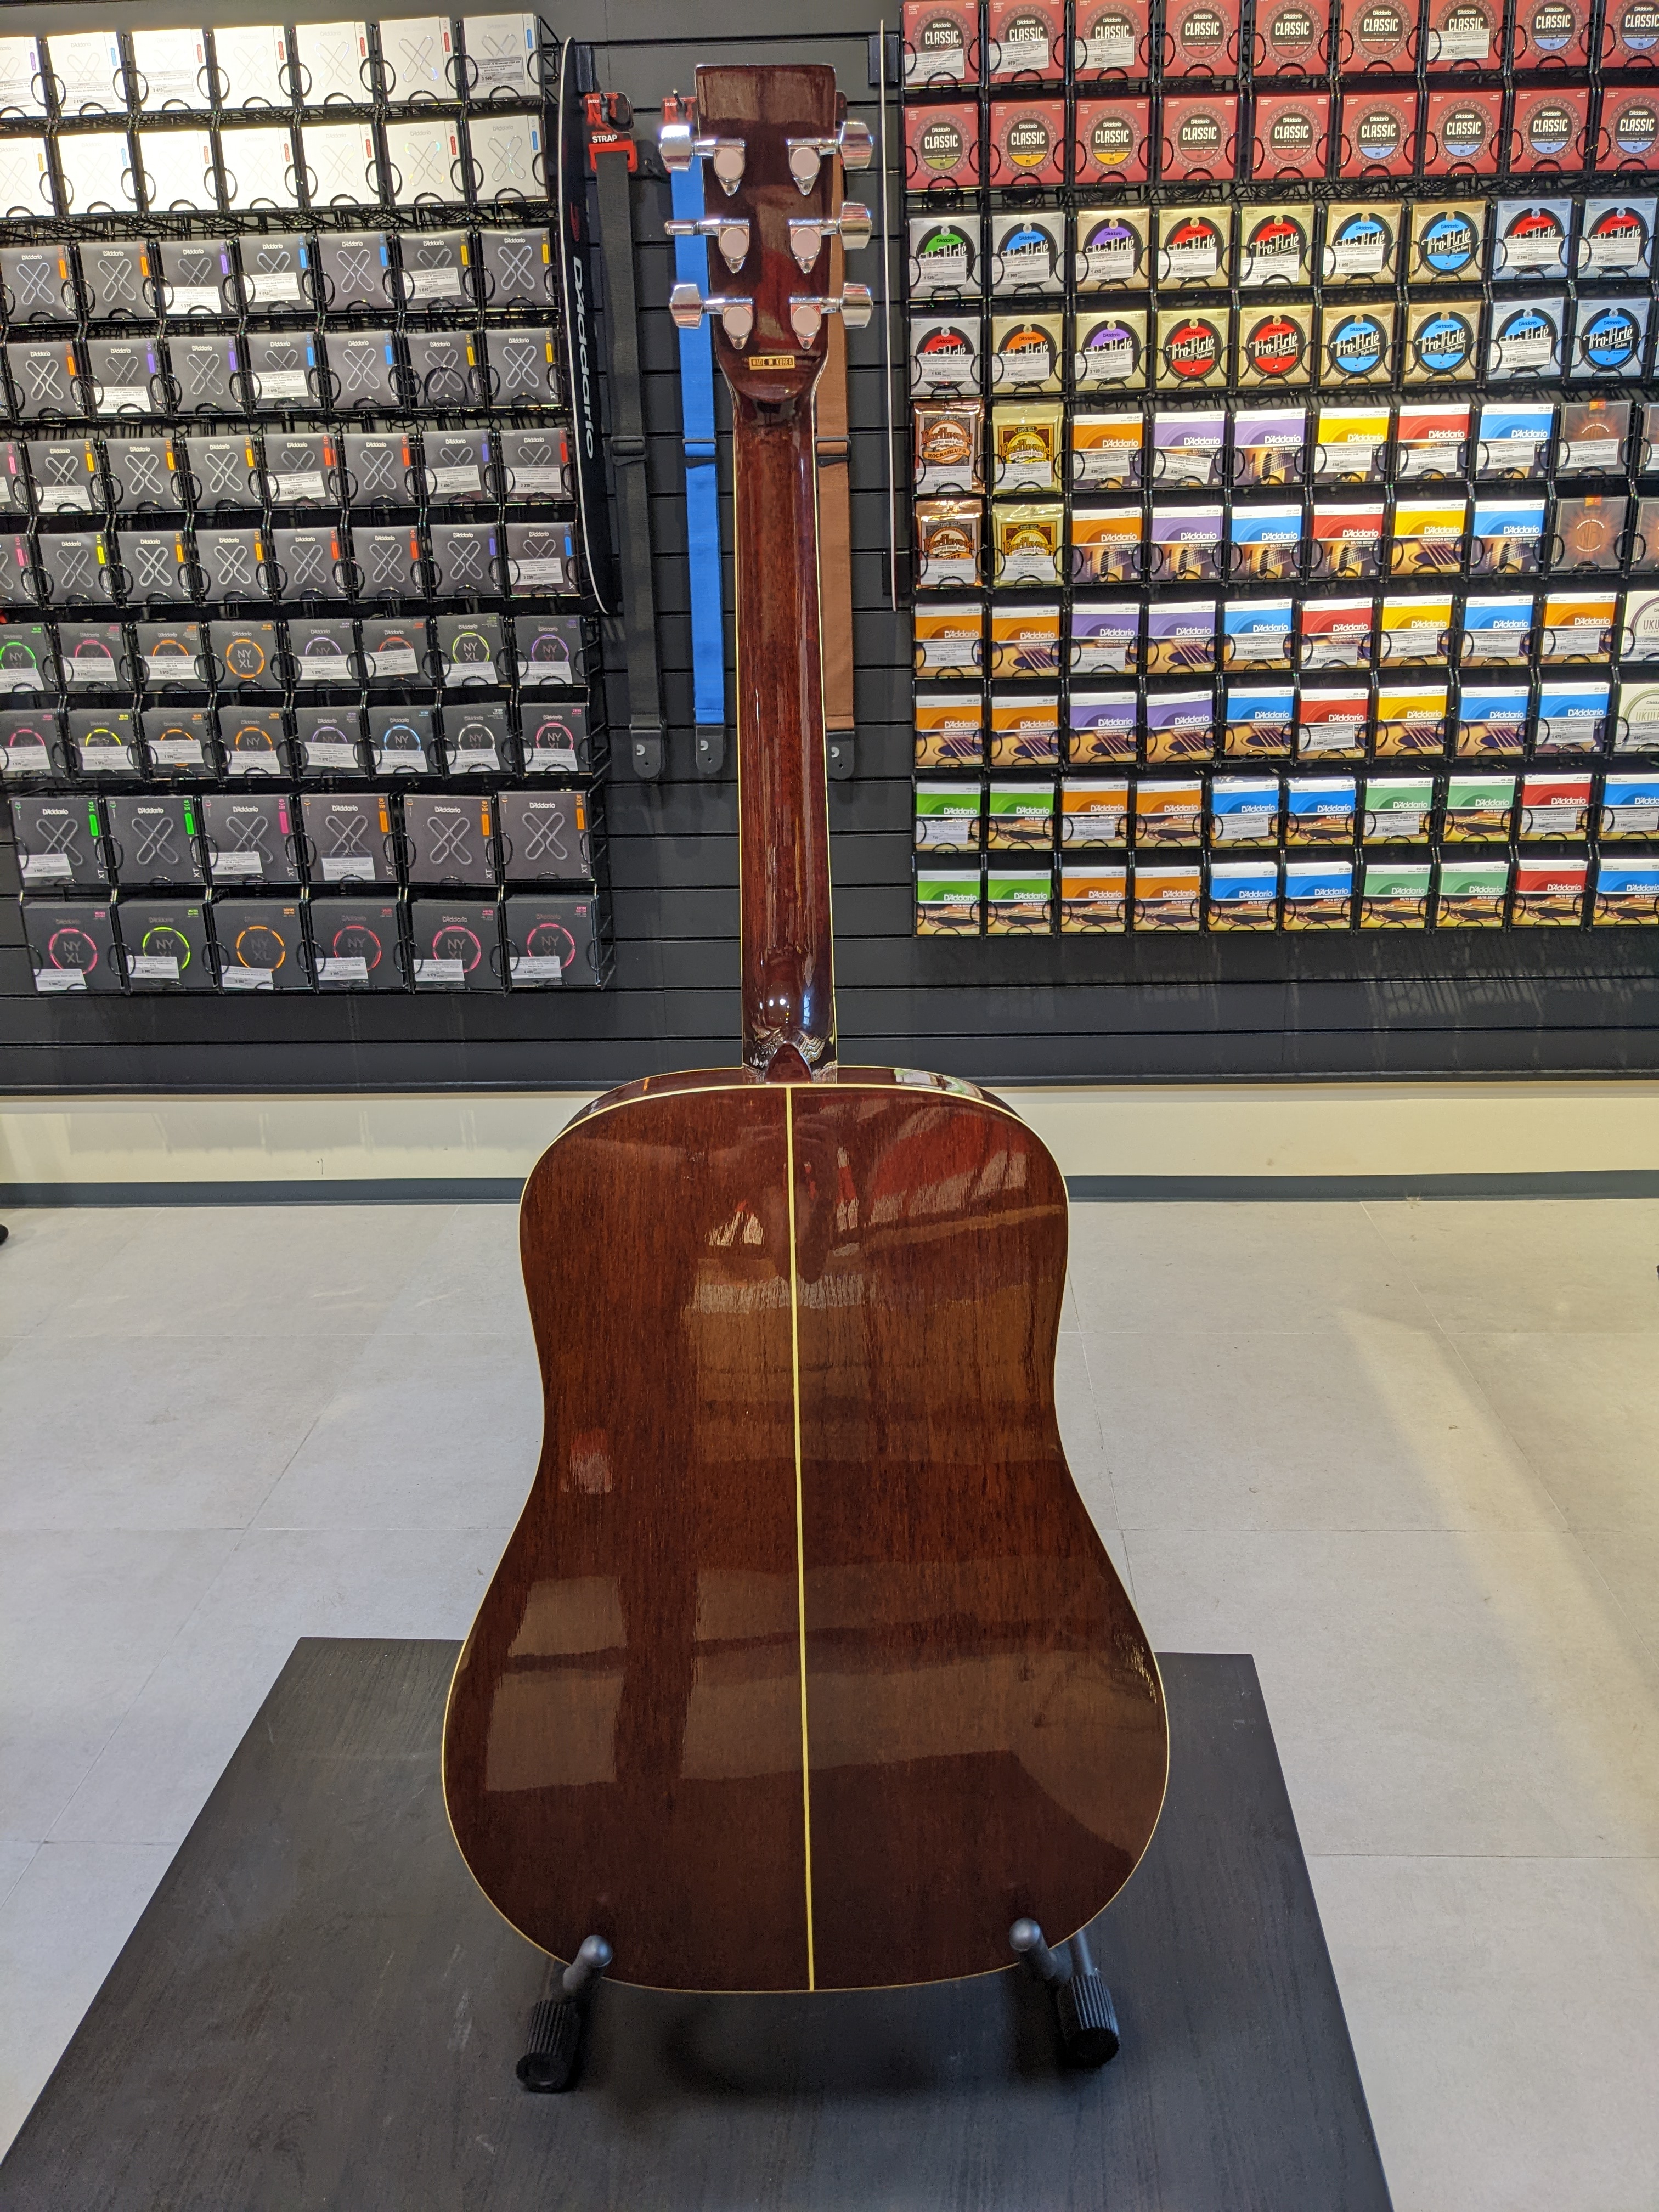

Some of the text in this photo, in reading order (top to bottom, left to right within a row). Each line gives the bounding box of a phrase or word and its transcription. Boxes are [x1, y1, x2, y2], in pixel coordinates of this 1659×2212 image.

[1364, 19, 1398, 32] CLASSIC
[1448, 17, 1483, 30] CLASSIC
[1536, 15, 1571, 30] CLASSIC
[1625, 14, 1659, 28] CLASSIC
[1095, 25, 1129, 39] CLASSIC
[1184, 23, 1220, 36] CLASSIC
[1275, 22, 1310, 35] CLASSIC
[924, 32, 959, 45] CLASSIC
[1009, 28, 1043, 42] CLASSIC
[1447, 121, 1481, 134] CLASSIC
[1533, 119, 1568, 133] CLASSIC
[1620, 119, 1654, 132] CLASSIC
[1182, 127, 1217, 140] CLASSIC
[1274, 126, 1309, 138] CLASSIC
[1361, 124, 1396, 137] CLASSIC
[592, 134, 618, 143] STRAP
[1011, 132, 1045, 145] CLASSIC
[1095, 129, 1129, 143] CLASSIC
[924, 136, 958, 149] CLASSIC
[573, 256, 594, 459] D'Addario
[1265, 434, 1301, 443] D'Addario
[1347, 433, 1384, 442] D'Addario
[1428, 430, 1464, 438] D'Addario
[1511, 430, 1548, 438] D'Addario
[1102, 439, 1139, 448] D'Addario
[1184, 436, 1220, 445] D'Addario
[1343, 528, 1379, 538] D'Addario
[1424, 526, 1460, 534] D'Addario
[1503, 525, 1539, 534] D'Addario
[1101, 532, 1137, 542] D'Addario
[1181, 532, 1216, 541] D'Addario
[1261, 531, 1297, 540] D'Addario
[1411, 619, 1447, 629] D'Addario
[1574, 617, 1610, 626] D'Addario
[1176, 627, 1211, 635] D'Addario
[1253, 623, 1289, 632] D'Addario
[1333, 623, 1368, 632] D'Addario
[944, 630, 979, 639] D'Addario
[1020, 631, 1055, 640] D'Addario
[1099, 628, 1135, 637] D'Addario
[464, 643, 477, 652] NY
[238, 650, 252, 658] NY
[466, 652, 479, 661] XL
[240, 659, 253, 668] XL
[1255, 711, 1289, 719] D'Addario
[1407, 710, 1442, 718] D'Addario
[1489, 710, 1525, 719] D'Addario
[1568, 708, 1604, 717] D'Addario
[1098, 718, 1133, 726] D'Addario
[1175, 715, 1209, 725] D'Addario
[1329, 713, 1364, 722] D'Addario
[944, 721, 979, 729] D'Addario
[395, 735, 409, 743] NY
[1393, 800, 1427, 809] D'Addario
[1474, 798, 1509, 806] D'Addario
[1551, 797, 1585, 805] D'Addario
[944, 806, 977, 815] D'Addario
[1016, 806, 1049, 815] D'Addario
[1091, 804, 1124, 812] D'Addario
[1164, 804, 1198, 812] D'Addario
[1241, 803, 1275, 812] D'Addario
[1317, 803, 1352, 812] D'Addario
[98, 870, 105, 879] XT
[194, 868, 200, 877] XT
[386, 866, 393, 876] XT
[486, 869, 492, 878] XT
[1391, 886, 1425, 895] D'Addario
[1469, 885, 1503, 894] D'Addario
[1547, 883, 1582, 891] D'Addario
[1014, 891, 1047, 900] D'Addario
[1088, 890, 1122, 899] D'Addario
[1163, 889, 1197, 898] D'Addario
[1239, 890, 1273, 898] D'Addario
[63, 941, 80, 951] NY
[66, 953, 83, 963] XL
